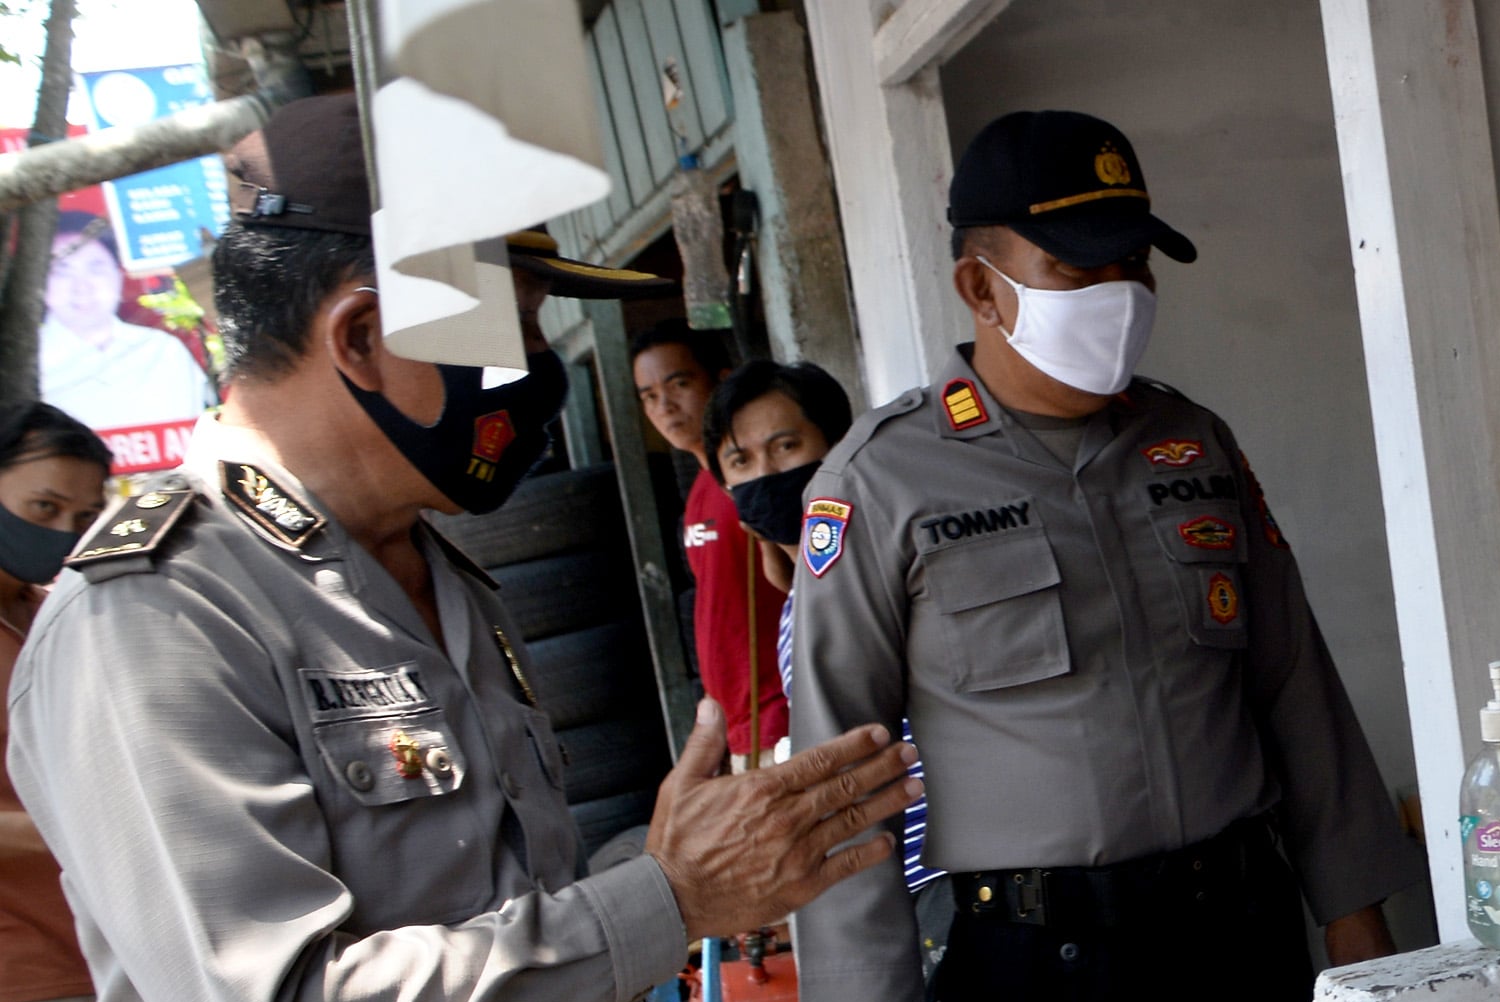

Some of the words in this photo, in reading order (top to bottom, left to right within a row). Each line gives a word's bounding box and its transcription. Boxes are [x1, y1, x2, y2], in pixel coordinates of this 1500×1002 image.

[103, 429, 160, 467] REI
[467, 458, 497, 482] TNI
[920, 501, 1029, 544] TOMMY
[1471, 853, 1499, 868] Hand
